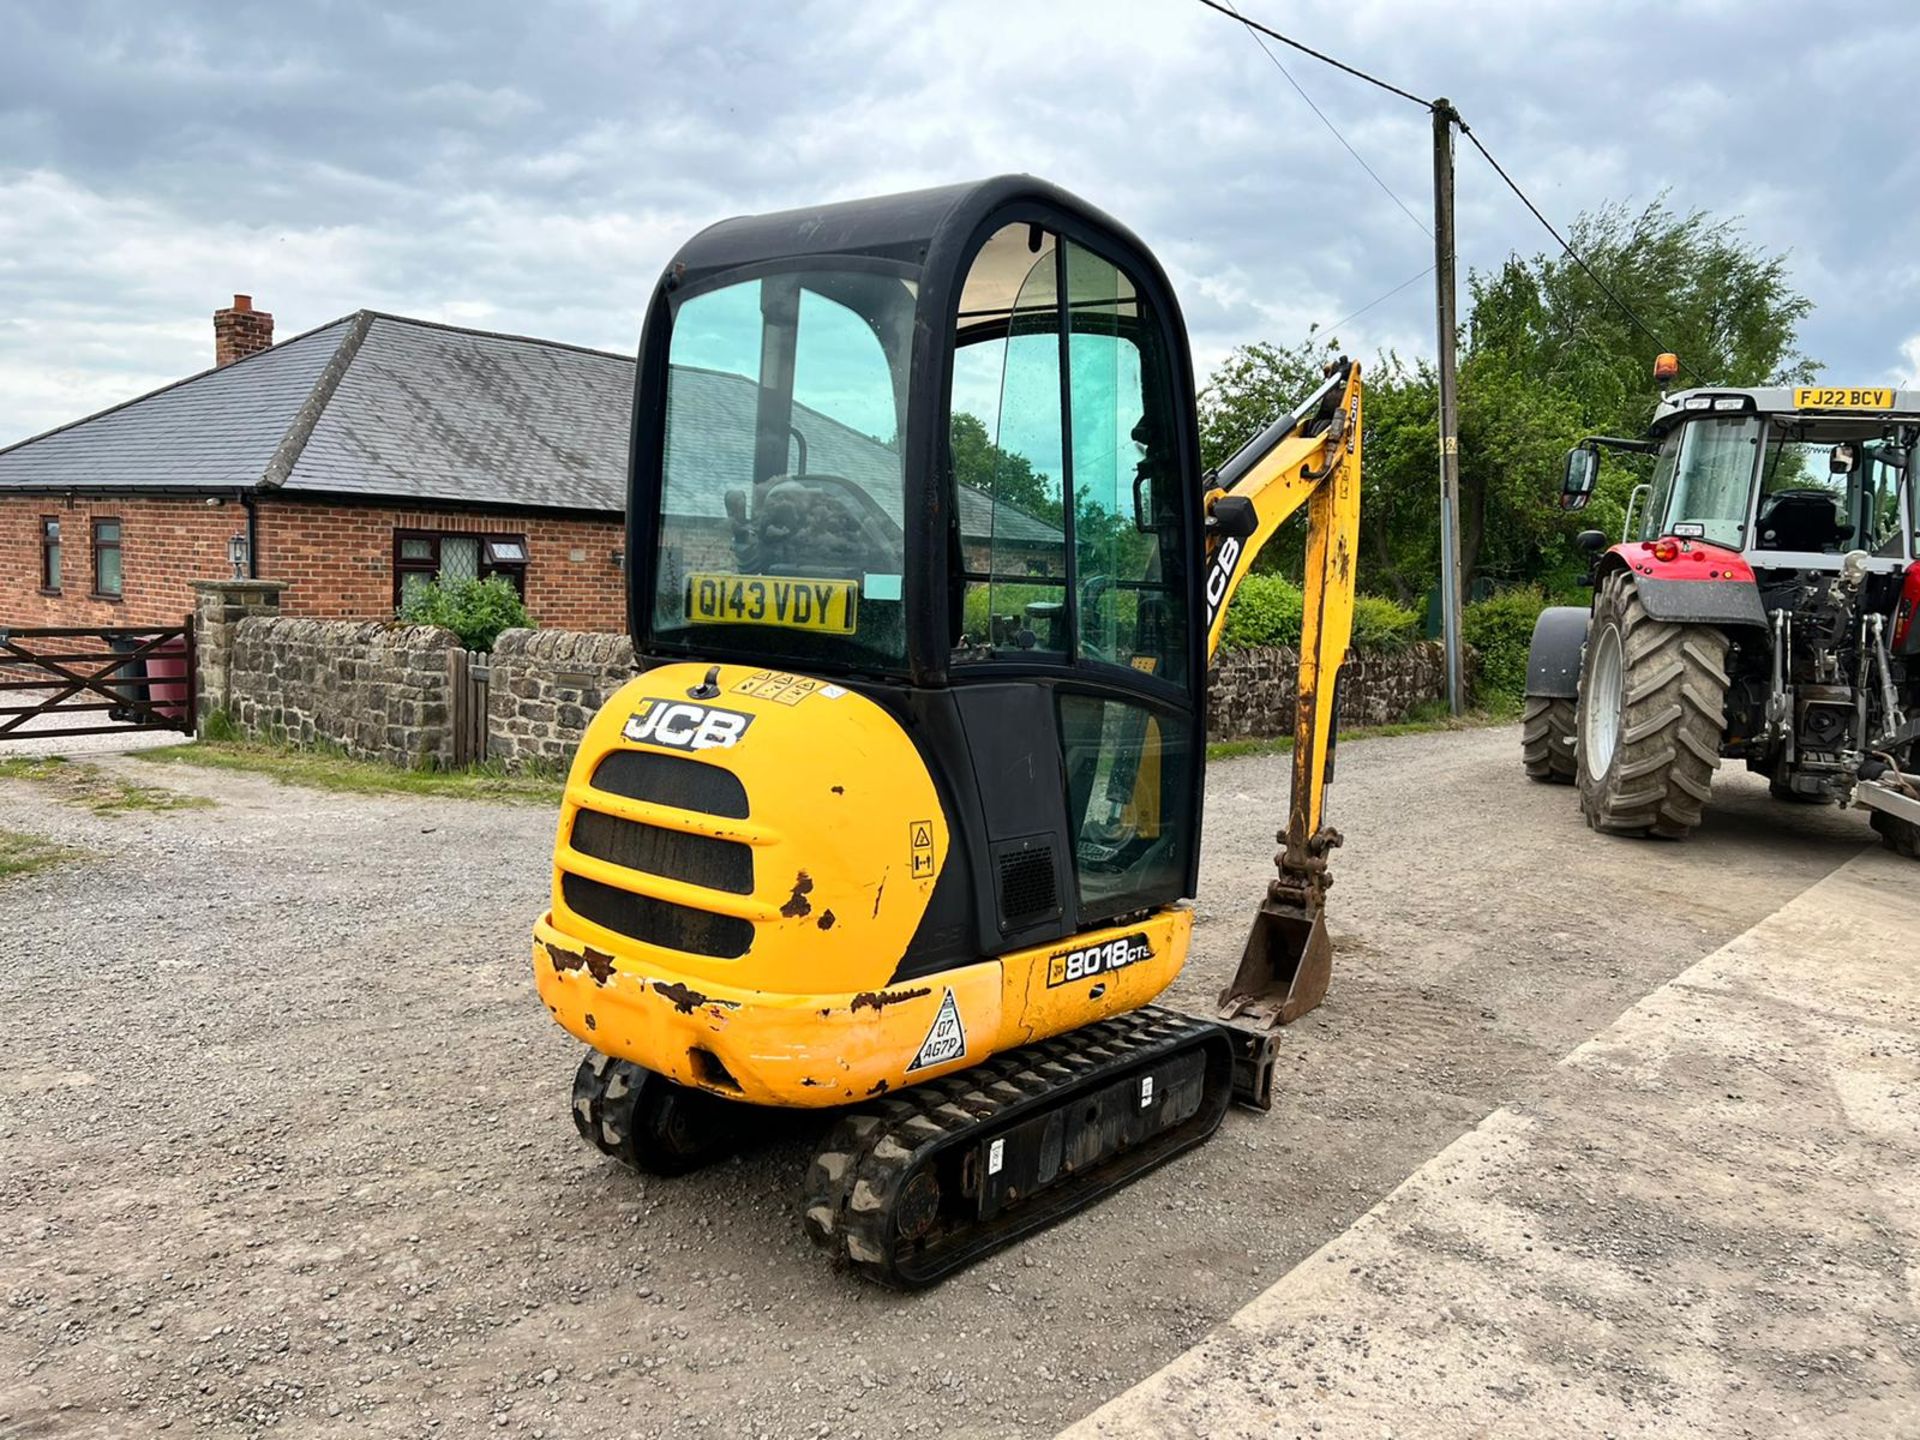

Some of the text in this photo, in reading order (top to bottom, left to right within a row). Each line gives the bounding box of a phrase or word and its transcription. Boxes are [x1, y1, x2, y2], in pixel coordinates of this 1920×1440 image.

[1801, 391, 1883, 405] FJ22 BCV
[700, 580, 833, 624] Q143 VDY
[624, 702, 746, 749] JCB
[924, 1037, 957, 1059] AG7P
